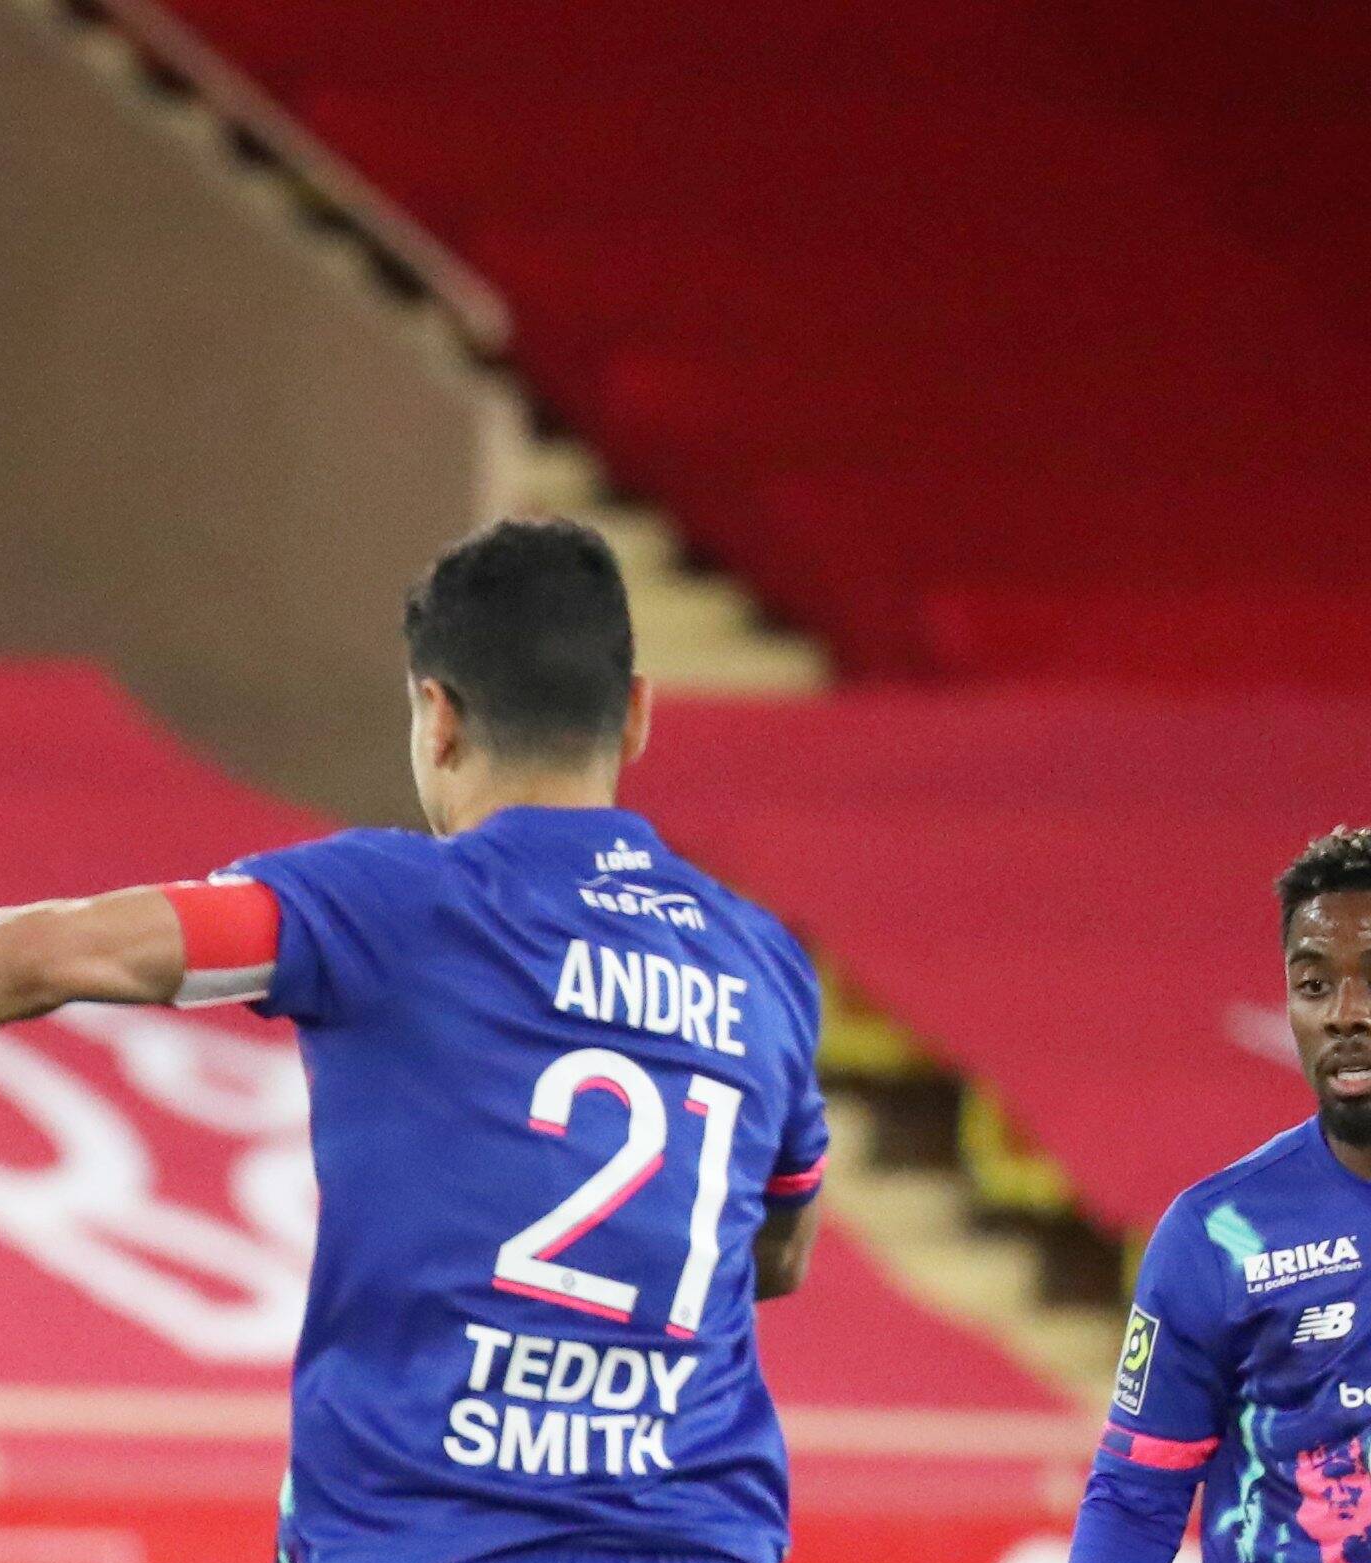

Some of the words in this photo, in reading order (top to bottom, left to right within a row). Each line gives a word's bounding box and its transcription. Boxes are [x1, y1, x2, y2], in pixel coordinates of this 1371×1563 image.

[554, 938, 748, 1056] ANDRE
[492, 1047, 742, 1338] 21
[464, 1322, 697, 1415] TEDDY
[443, 1399, 674, 1477] SMITH
